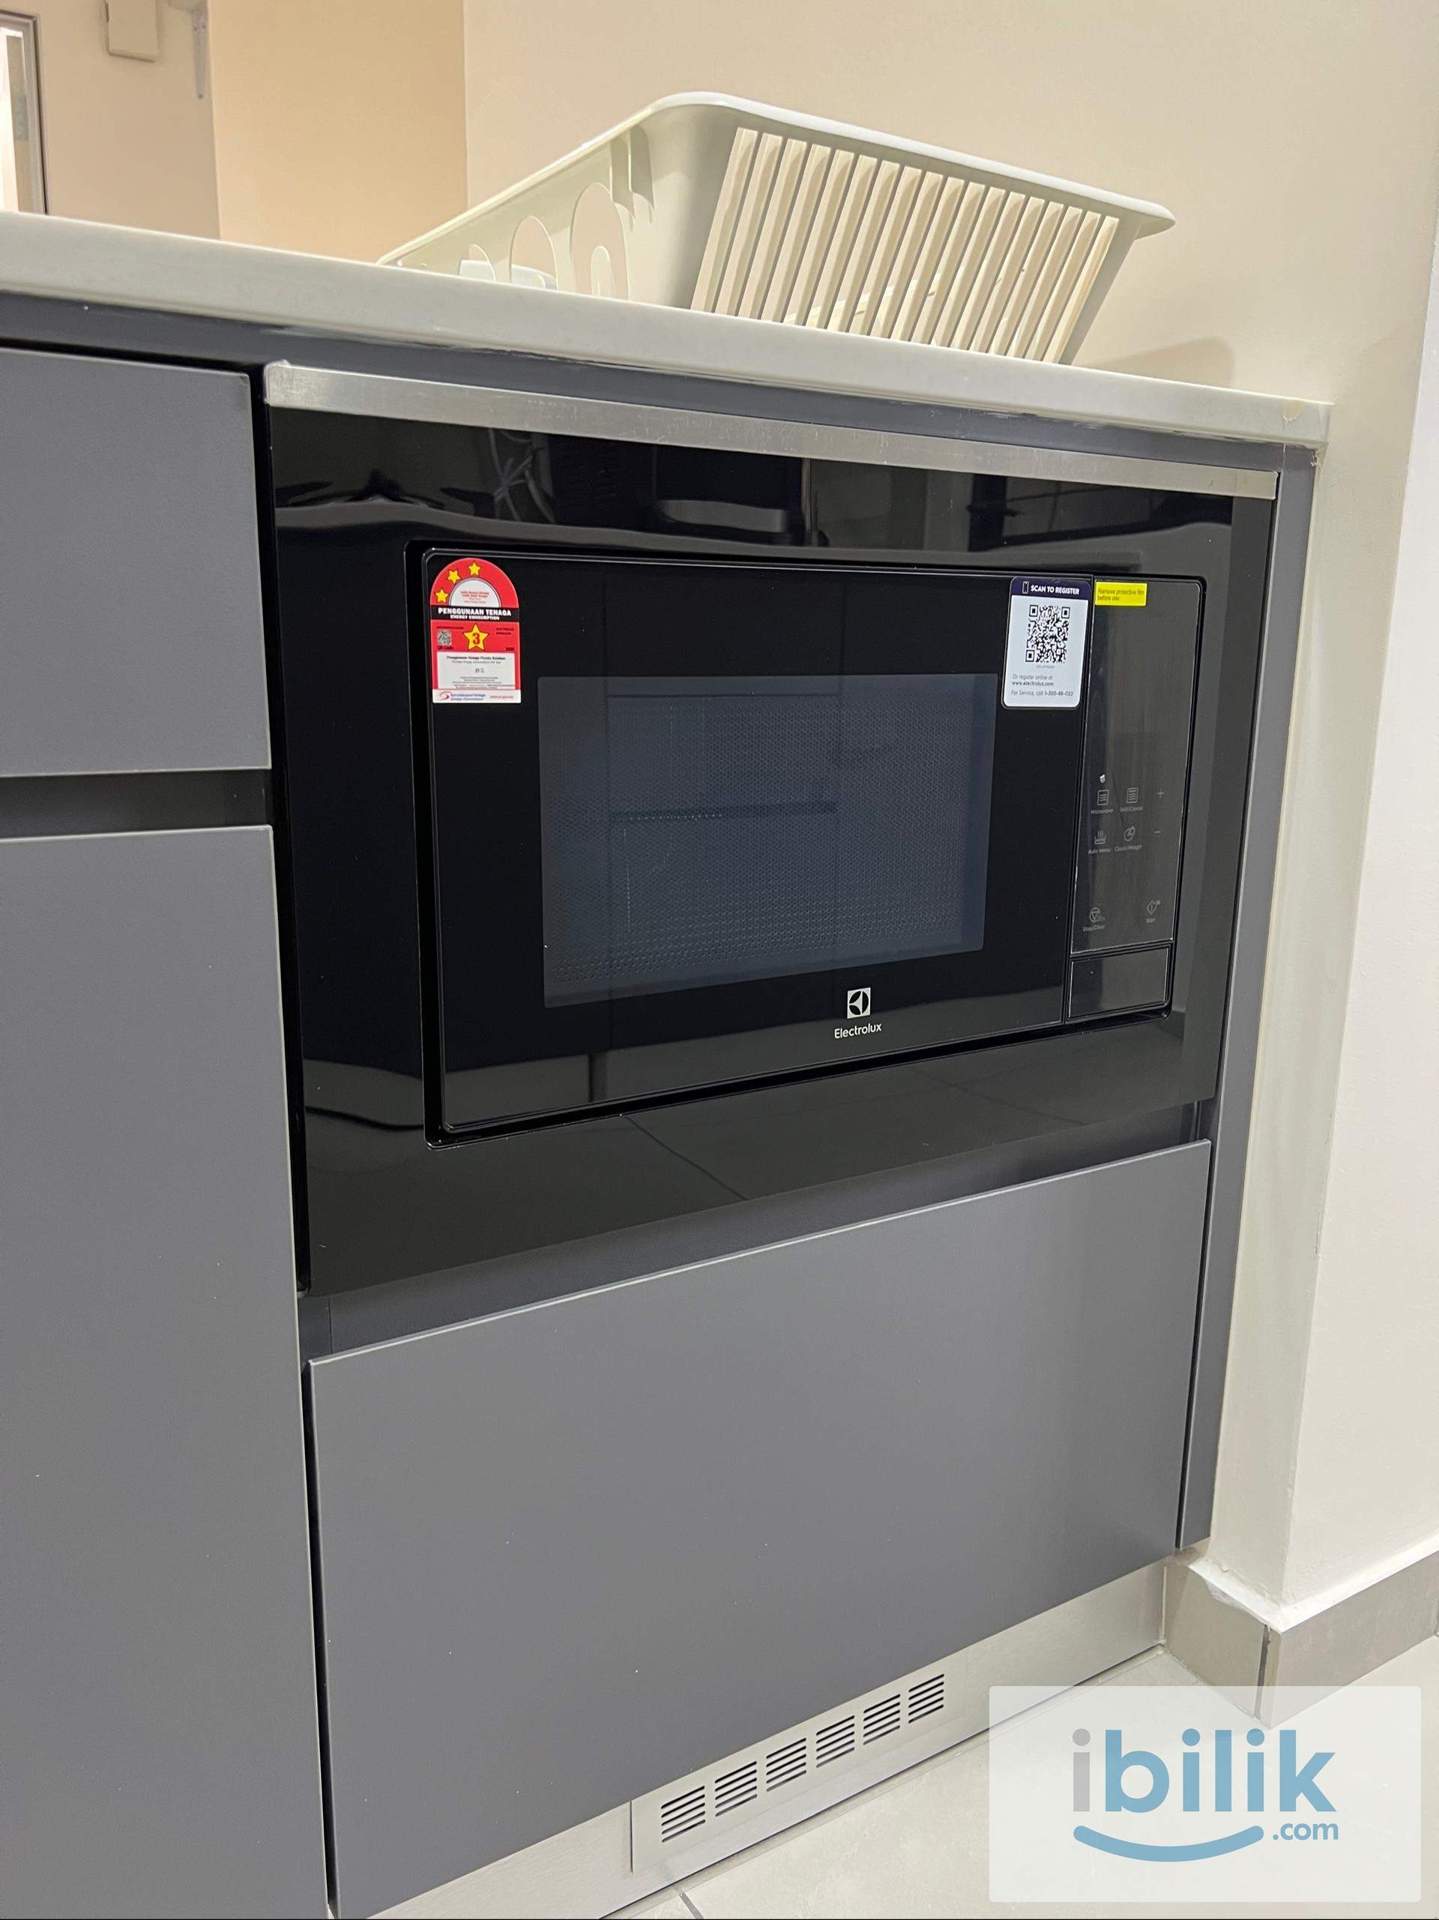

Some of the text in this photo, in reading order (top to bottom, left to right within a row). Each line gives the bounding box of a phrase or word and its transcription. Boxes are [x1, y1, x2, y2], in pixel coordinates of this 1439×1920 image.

[1030, 584, 1046, 593] SCAN
[1055, 586, 1080, 595] REGISTER
[437, 607, 512, 617] PENGGUNAAN TENAGA
[472, 632, 480, 645] 3
[834, 1023, 882, 1039] Electrolux
